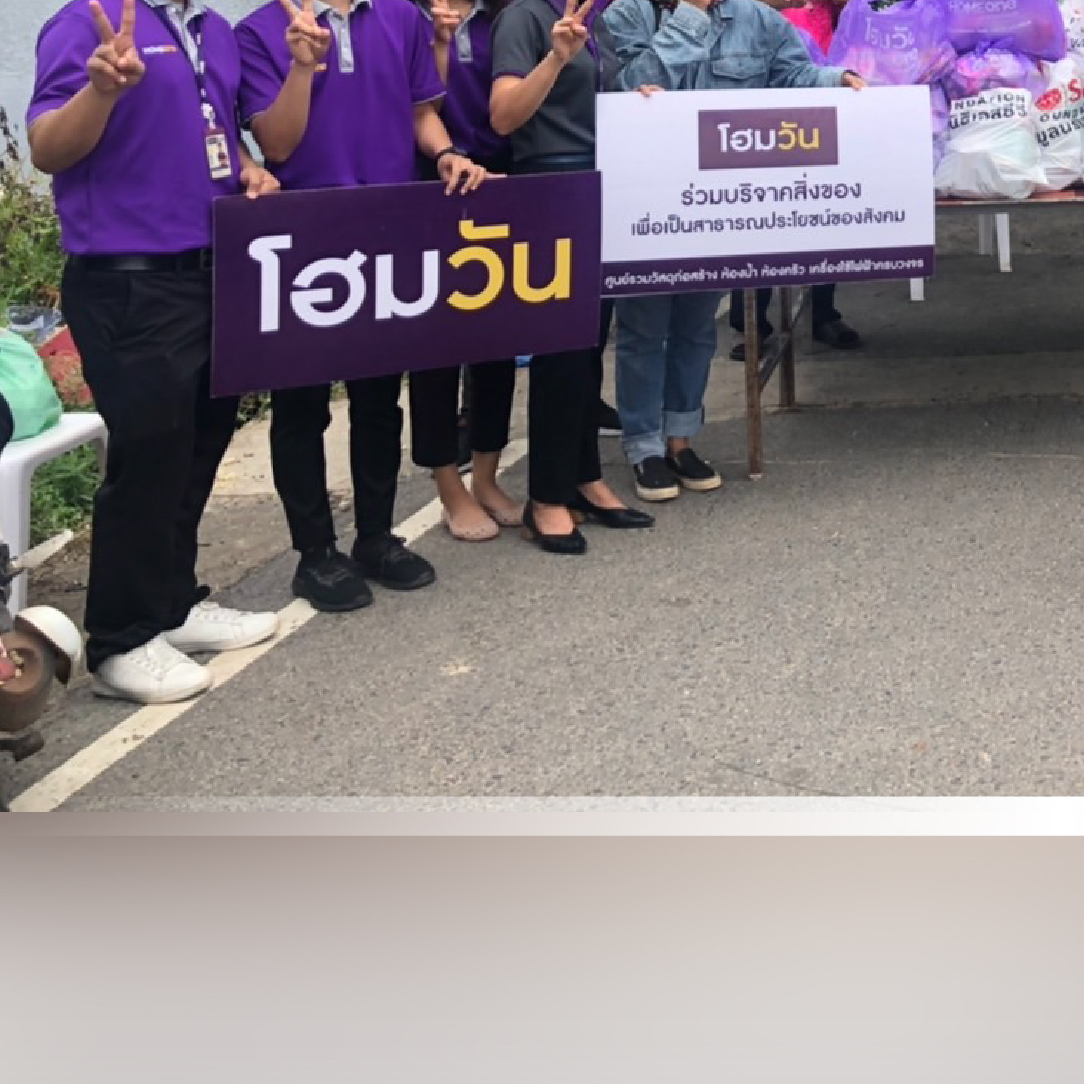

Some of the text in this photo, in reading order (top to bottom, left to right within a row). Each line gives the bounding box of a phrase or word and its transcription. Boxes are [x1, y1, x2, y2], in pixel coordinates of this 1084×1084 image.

[717, 120, 820, 153] โฮมวัน
[681, 172, 862, 206] ร่วมบริจาคสิ่งของ
[631, 207, 906, 236] เพื่อเป็นสาธารณประโยชน์ของสังคม
[247, 219, 571, 333] โฮมวัน
